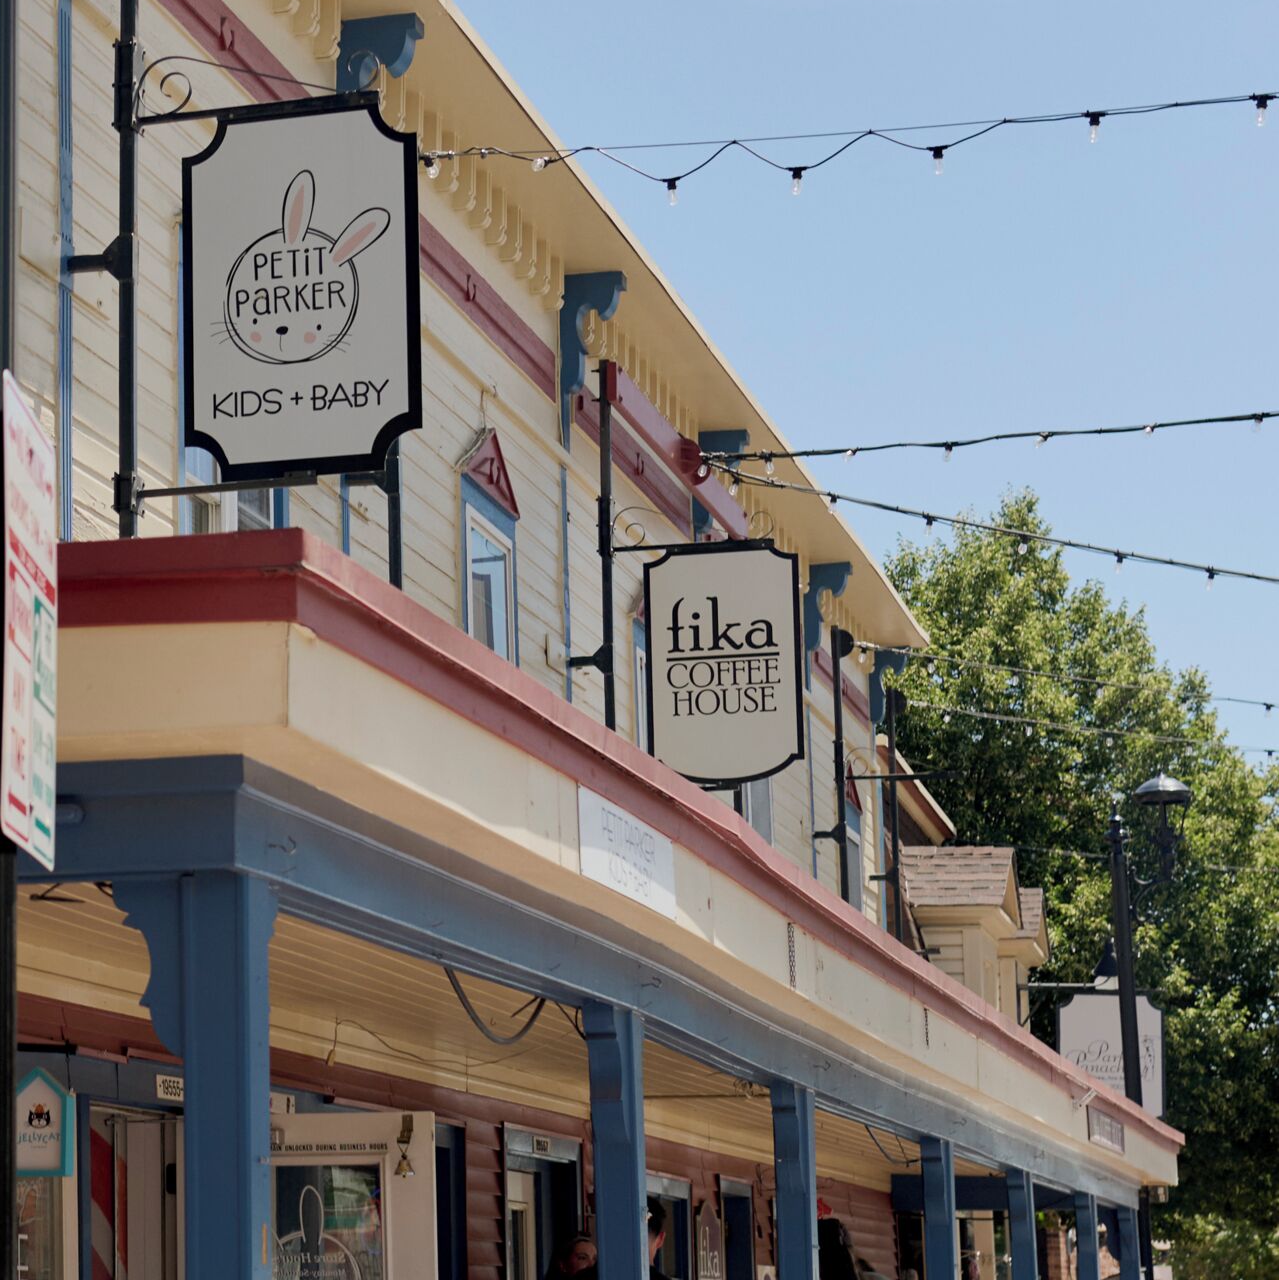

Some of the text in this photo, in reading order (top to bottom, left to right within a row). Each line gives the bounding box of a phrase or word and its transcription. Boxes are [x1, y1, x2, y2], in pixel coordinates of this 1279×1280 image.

[213, 388, 282, 420] KIDS
[311, 379, 389, 411] BABY
[666, 596, 779, 654] fika
[666, 658, 781, 689] COFFEE
[672, 686, 778, 717] HOUSE
[285, 1144, 313, 1152] UNLOCKED
[315, 1143, 337, 1151] DURING
[339, 1143, 367, 1151] BUSINESS
[369, 1142, 388, 1150] HOURS
[700, 1226, 720, 1277] fika
